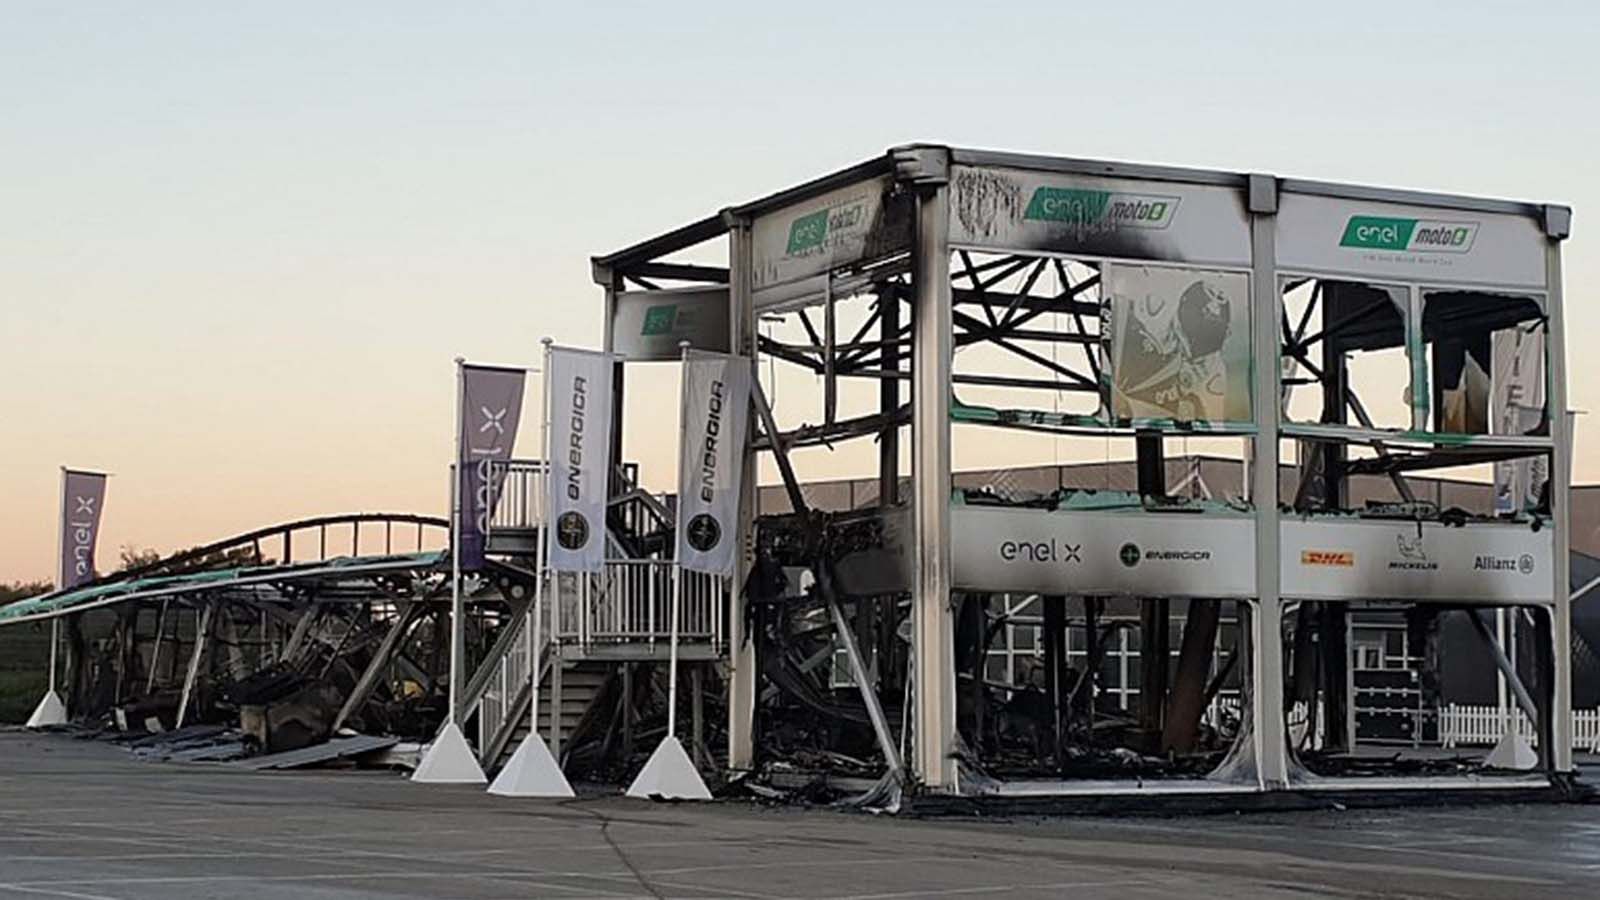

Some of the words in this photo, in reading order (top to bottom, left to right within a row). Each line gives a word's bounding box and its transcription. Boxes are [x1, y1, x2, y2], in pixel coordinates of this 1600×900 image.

[1356, 224, 1398, 243] enel
[566, 375, 587, 501] ENERGICA
[701, 380, 724, 503] ENERGICA
[71, 519, 92, 577] enel
[1000, 538, 1057, 562] enel
[1308, 552, 1346, 565] DHL
[1388, 561, 1438, 570] MICHELIN
[1473, 555, 1517, 570] Allianz
